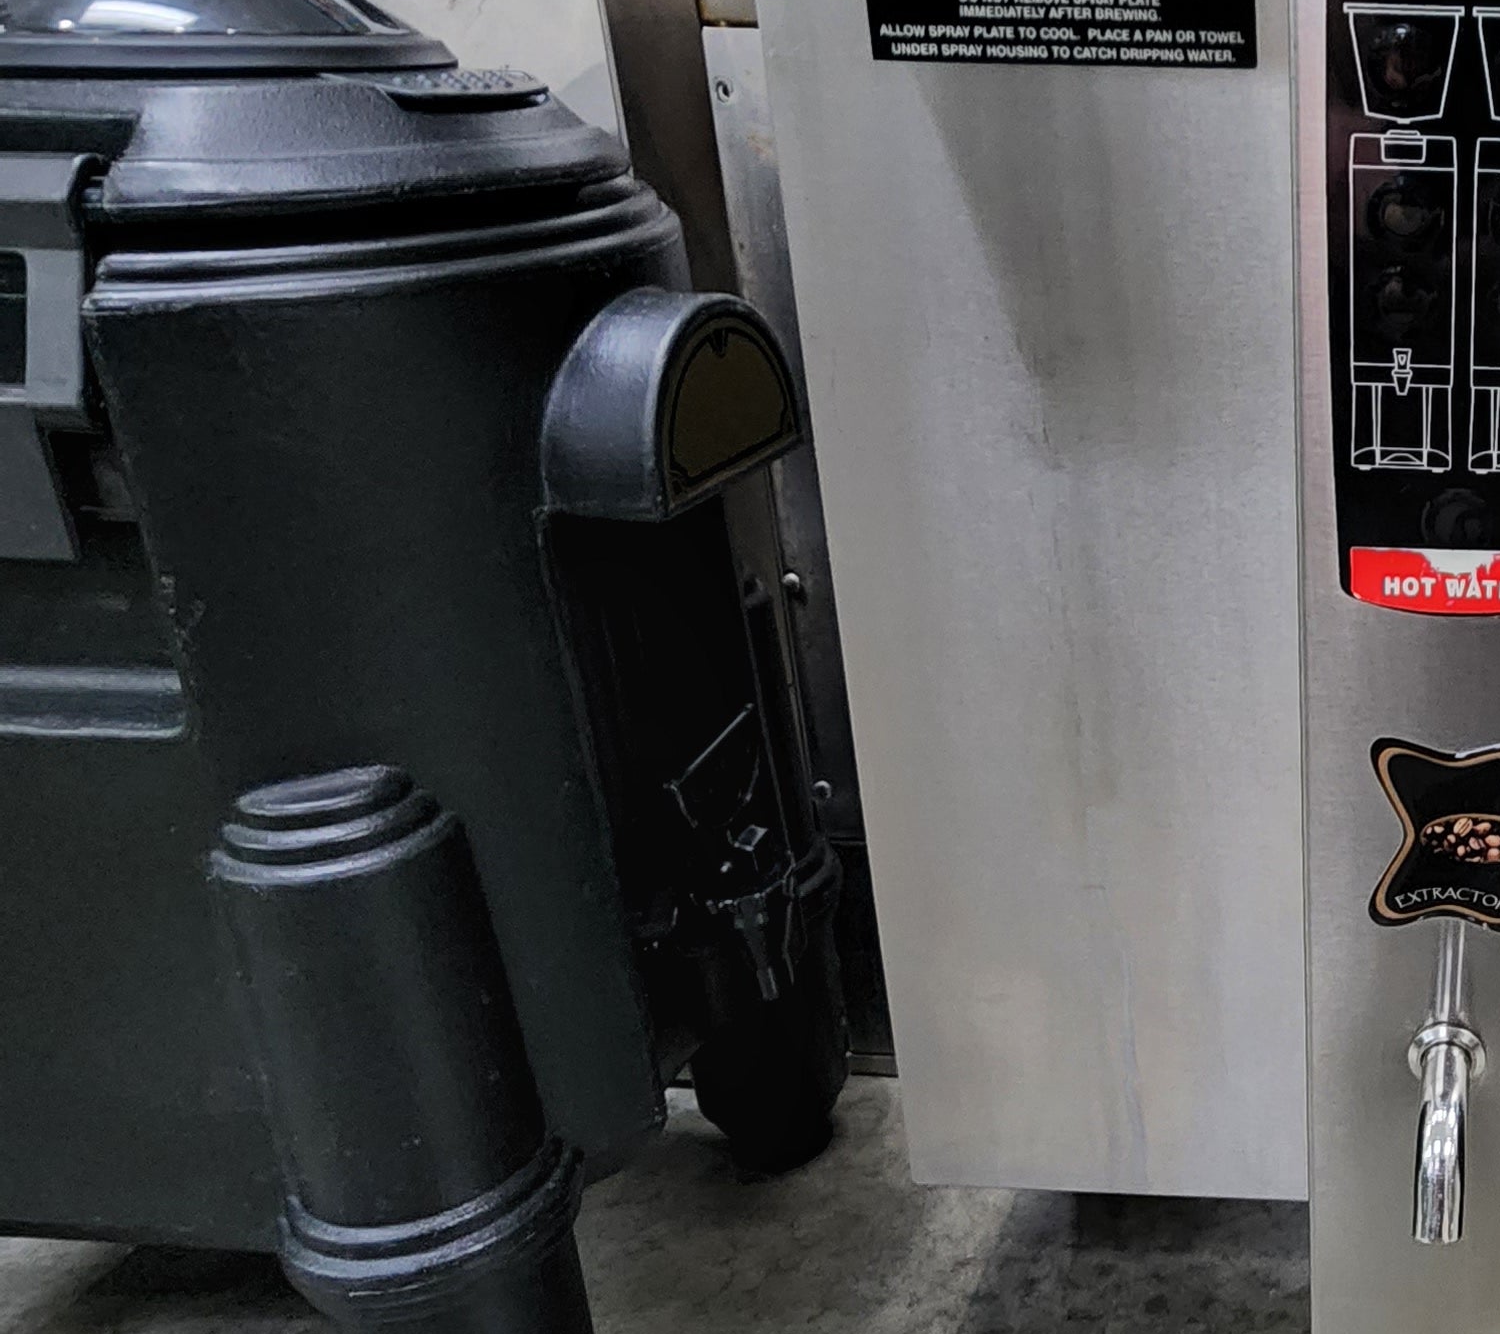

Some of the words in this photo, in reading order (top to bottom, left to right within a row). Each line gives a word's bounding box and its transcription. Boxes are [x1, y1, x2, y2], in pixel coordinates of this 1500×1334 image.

[959, 6, 1045, 19] IMMEDIATELY
[1048, 7, 1091, 20] AFTER
[879, 25, 925, 38] ALLOW
[928, 25, 970, 39] SPRAY
[973, 26, 1014, 40] PLATE
[1017, 27, 1037, 40] TO
[1087, 28, 1130, 42] PLACE
[1133, 29, 1143, 42] A
[1145, 29, 1172, 43] PAN
[1175, 29, 1195, 43] OR
[1198, 30, 1244, 44] TOWEL
[890, 43, 938, 56] UNDER
[940, 44, 983, 57] SPRAY
[985, 45, 1048, 59] HOUSING
[1051, 46, 1070, 59] TO
[1072, 46, 1117, 60] CATCH
[1119, 47, 1184, 62] DRIPPING
[1383, 576, 1436, 597] HOT
